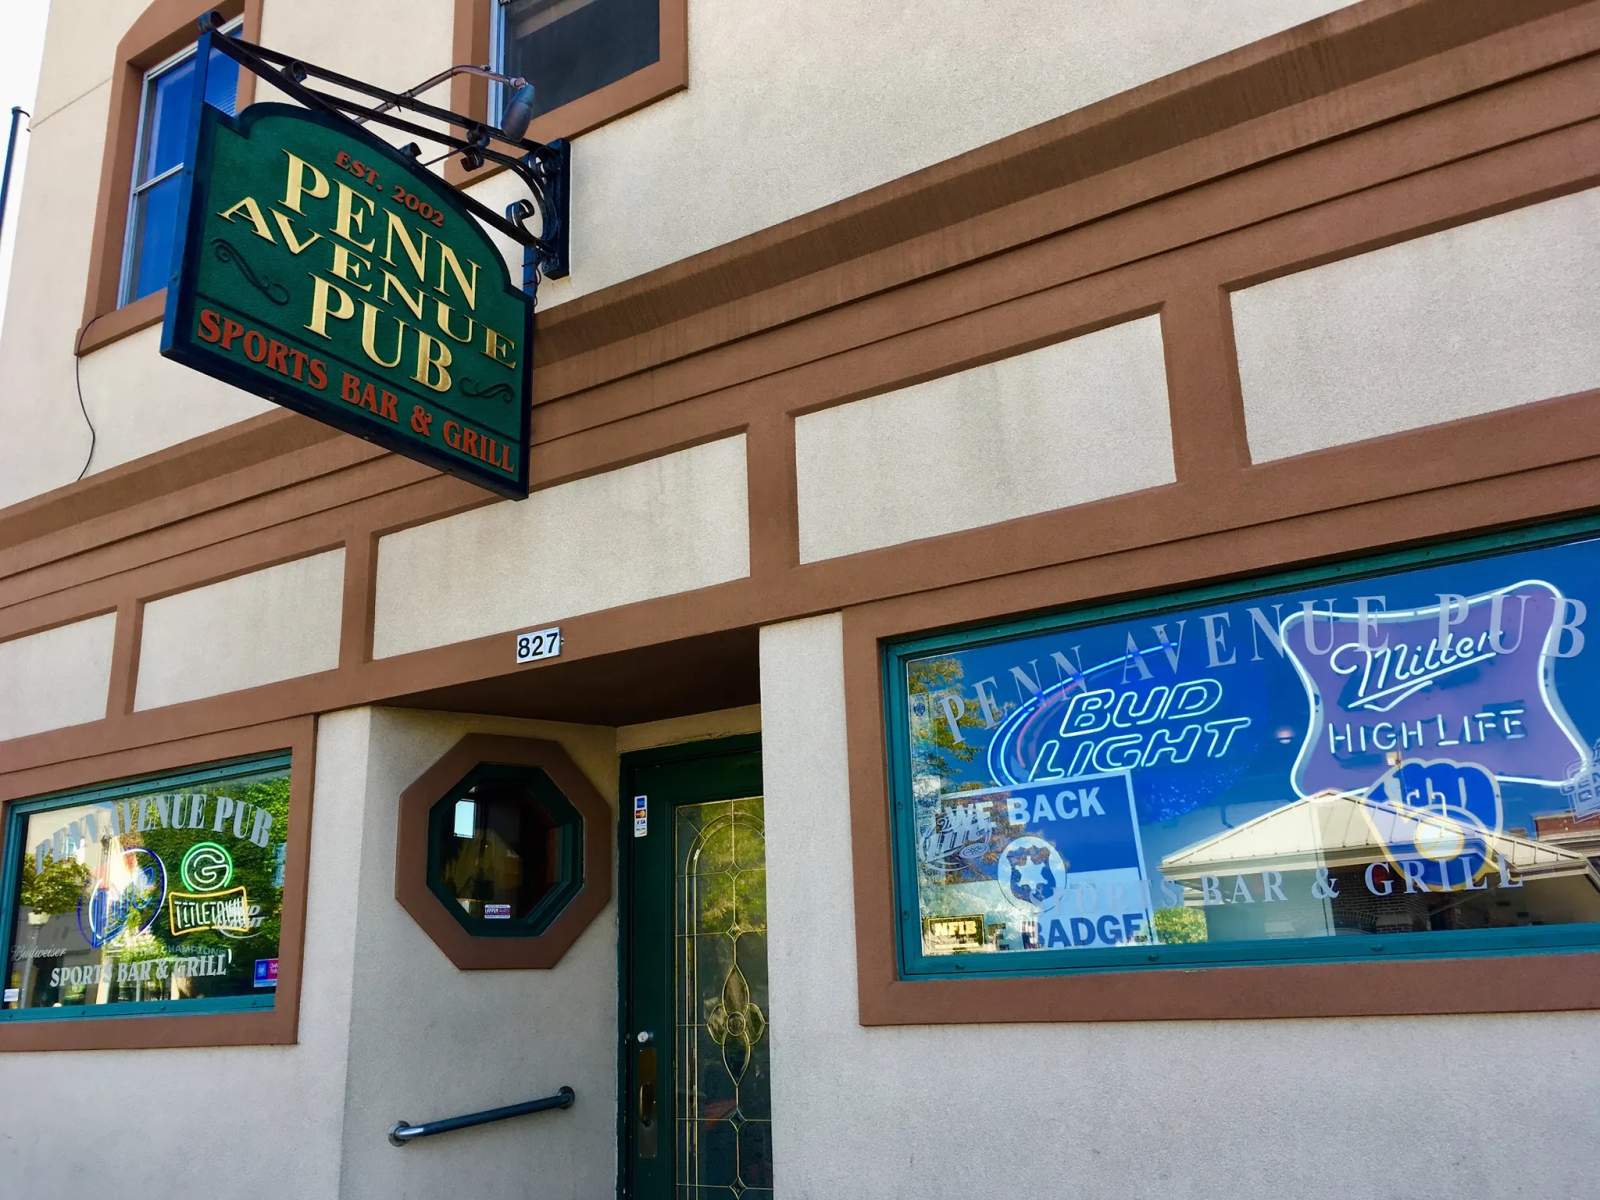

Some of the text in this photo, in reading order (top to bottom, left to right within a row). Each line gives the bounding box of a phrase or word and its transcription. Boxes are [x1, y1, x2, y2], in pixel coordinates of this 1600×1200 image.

[335, 151, 445, 227] EST. 2002
[278, 149, 481, 310] PENN
[217, 196, 517, 369] AVENUE
[304, 272, 453, 392] PUB
[197, 309, 516, 472] SPORTS BAR & GRILL
[517, 633, 559, 659] 827
[939, 593, 1588, 744] PENN AVENUE PUB
[1330, 631, 1504, 698] Miller
[1060, 678, 1223, 737] BUD
[1328, 710, 1525, 753] HIGH LIFE
[1028, 717, 1251, 782] LIGHT
[213, 796, 273, 848] PUB
[1006, 787, 1105, 825] BACK
[1202, 870, 1289, 905] BAR
[1311, 867, 1340, 898] &
[1365, 853, 1524, 897] GRILL
[49, 954, 227, 988] SPORTS BAR & GRILL
